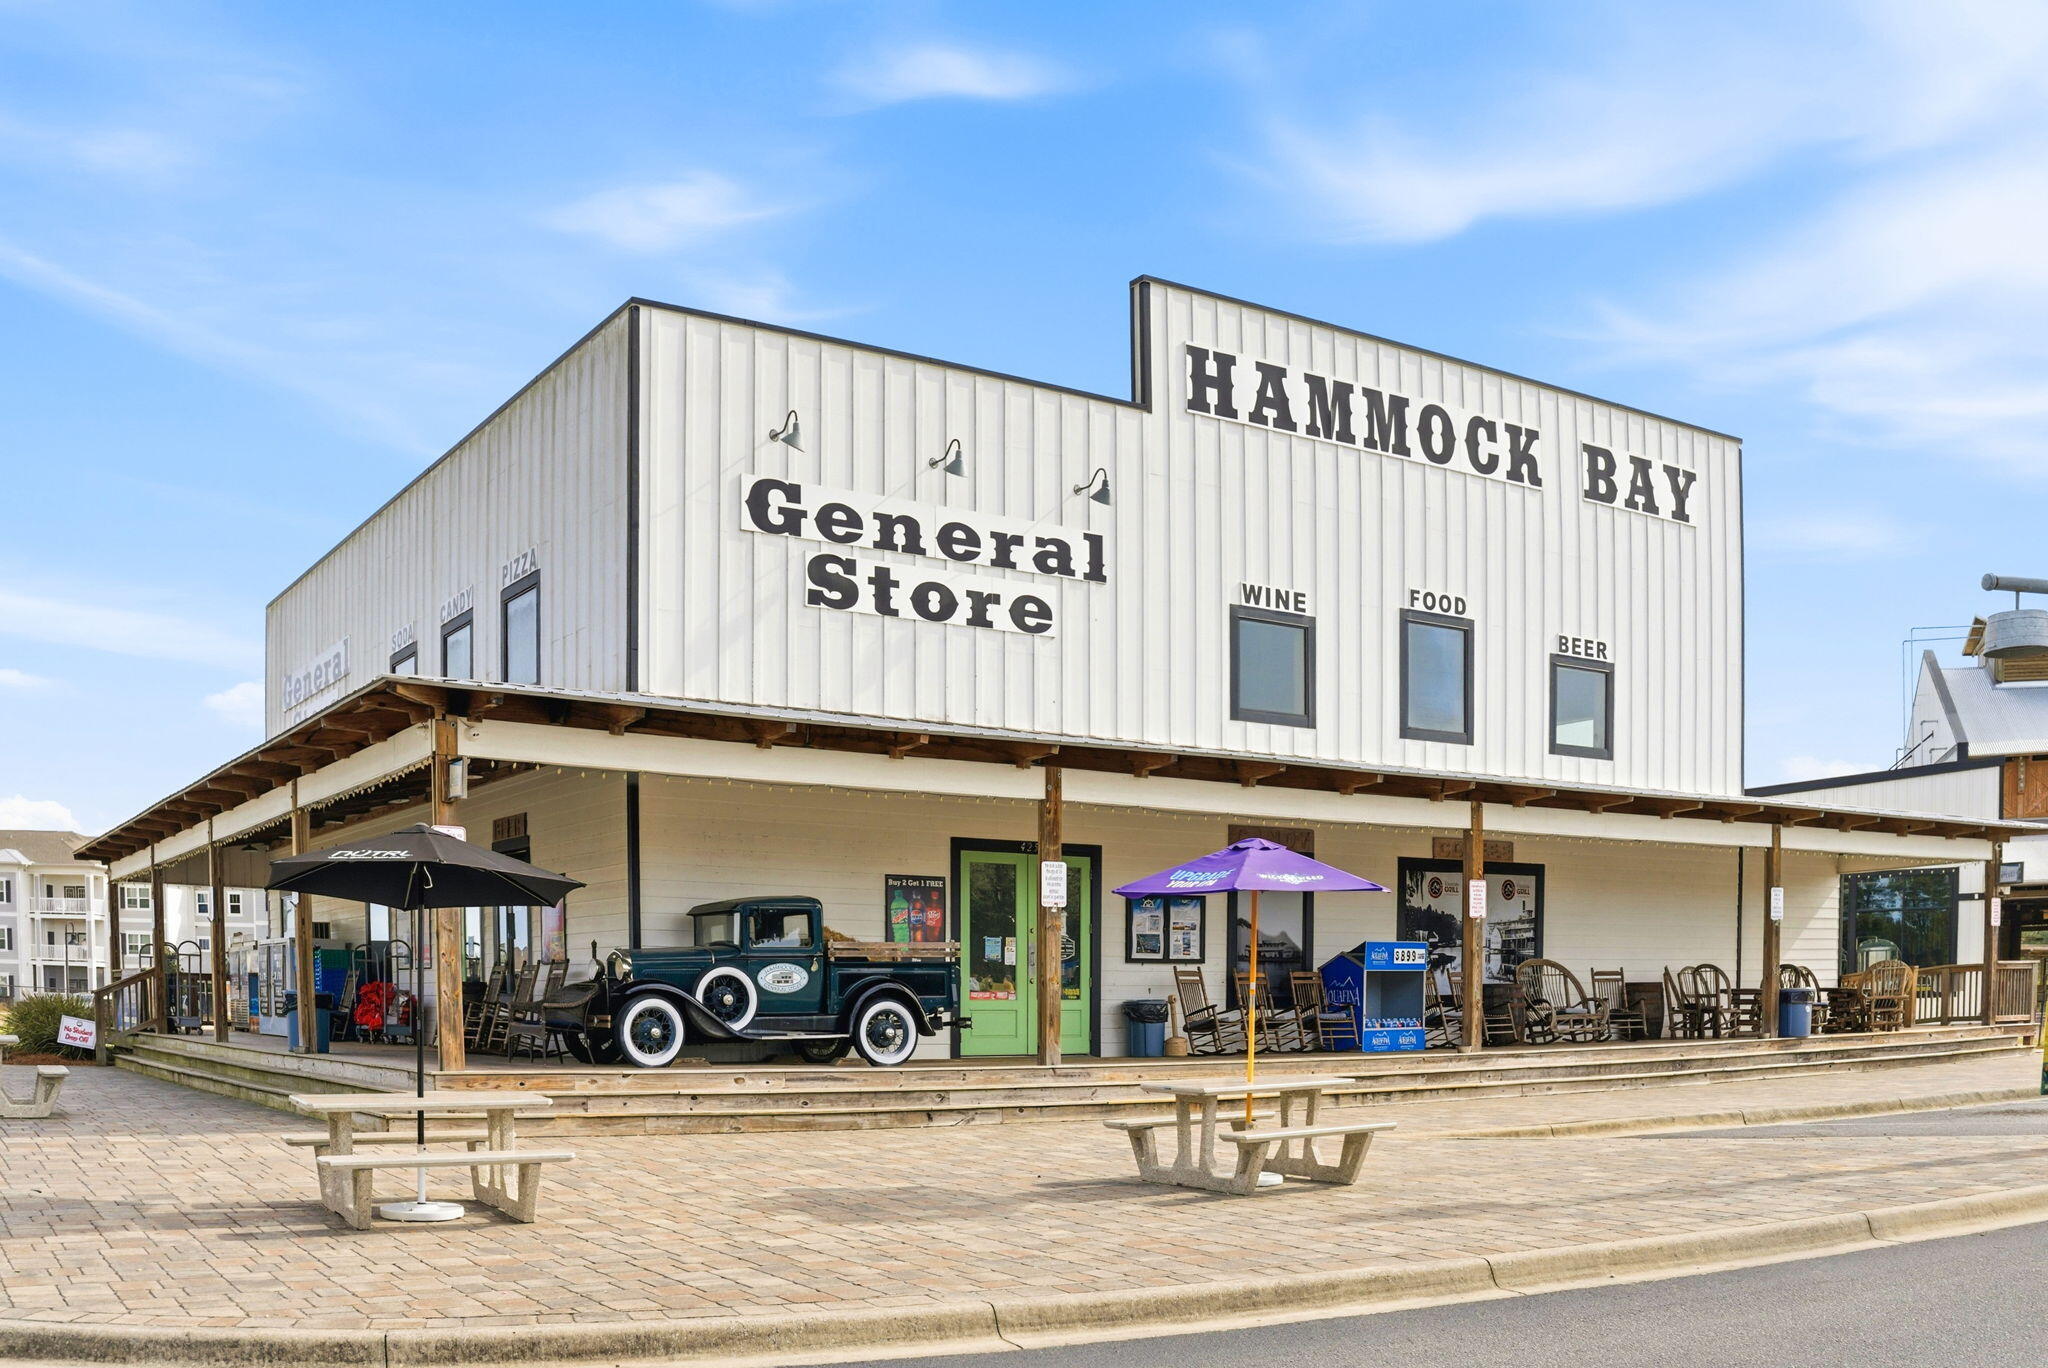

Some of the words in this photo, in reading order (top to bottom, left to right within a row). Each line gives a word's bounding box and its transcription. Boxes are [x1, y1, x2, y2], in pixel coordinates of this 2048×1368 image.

[1186, 344, 1542, 488] HAMMOCK
[1582, 442, 1697, 524] BAY
[745, 478, 1107, 583] General
[502, 548, 537, 586] PIZZA
[440, 586, 473, 624] CANDY
[806, 553, 1053, 634] Store
[1242, 583, 1307, 613] WINE
[1409, 589, 1467, 616] FOOD
[391, 622, 414, 651] SODA
[1558, 635, 1608, 660] BEER
[283, 638, 349, 708] General
[1170, 868, 1236, 881] UPGRADE
